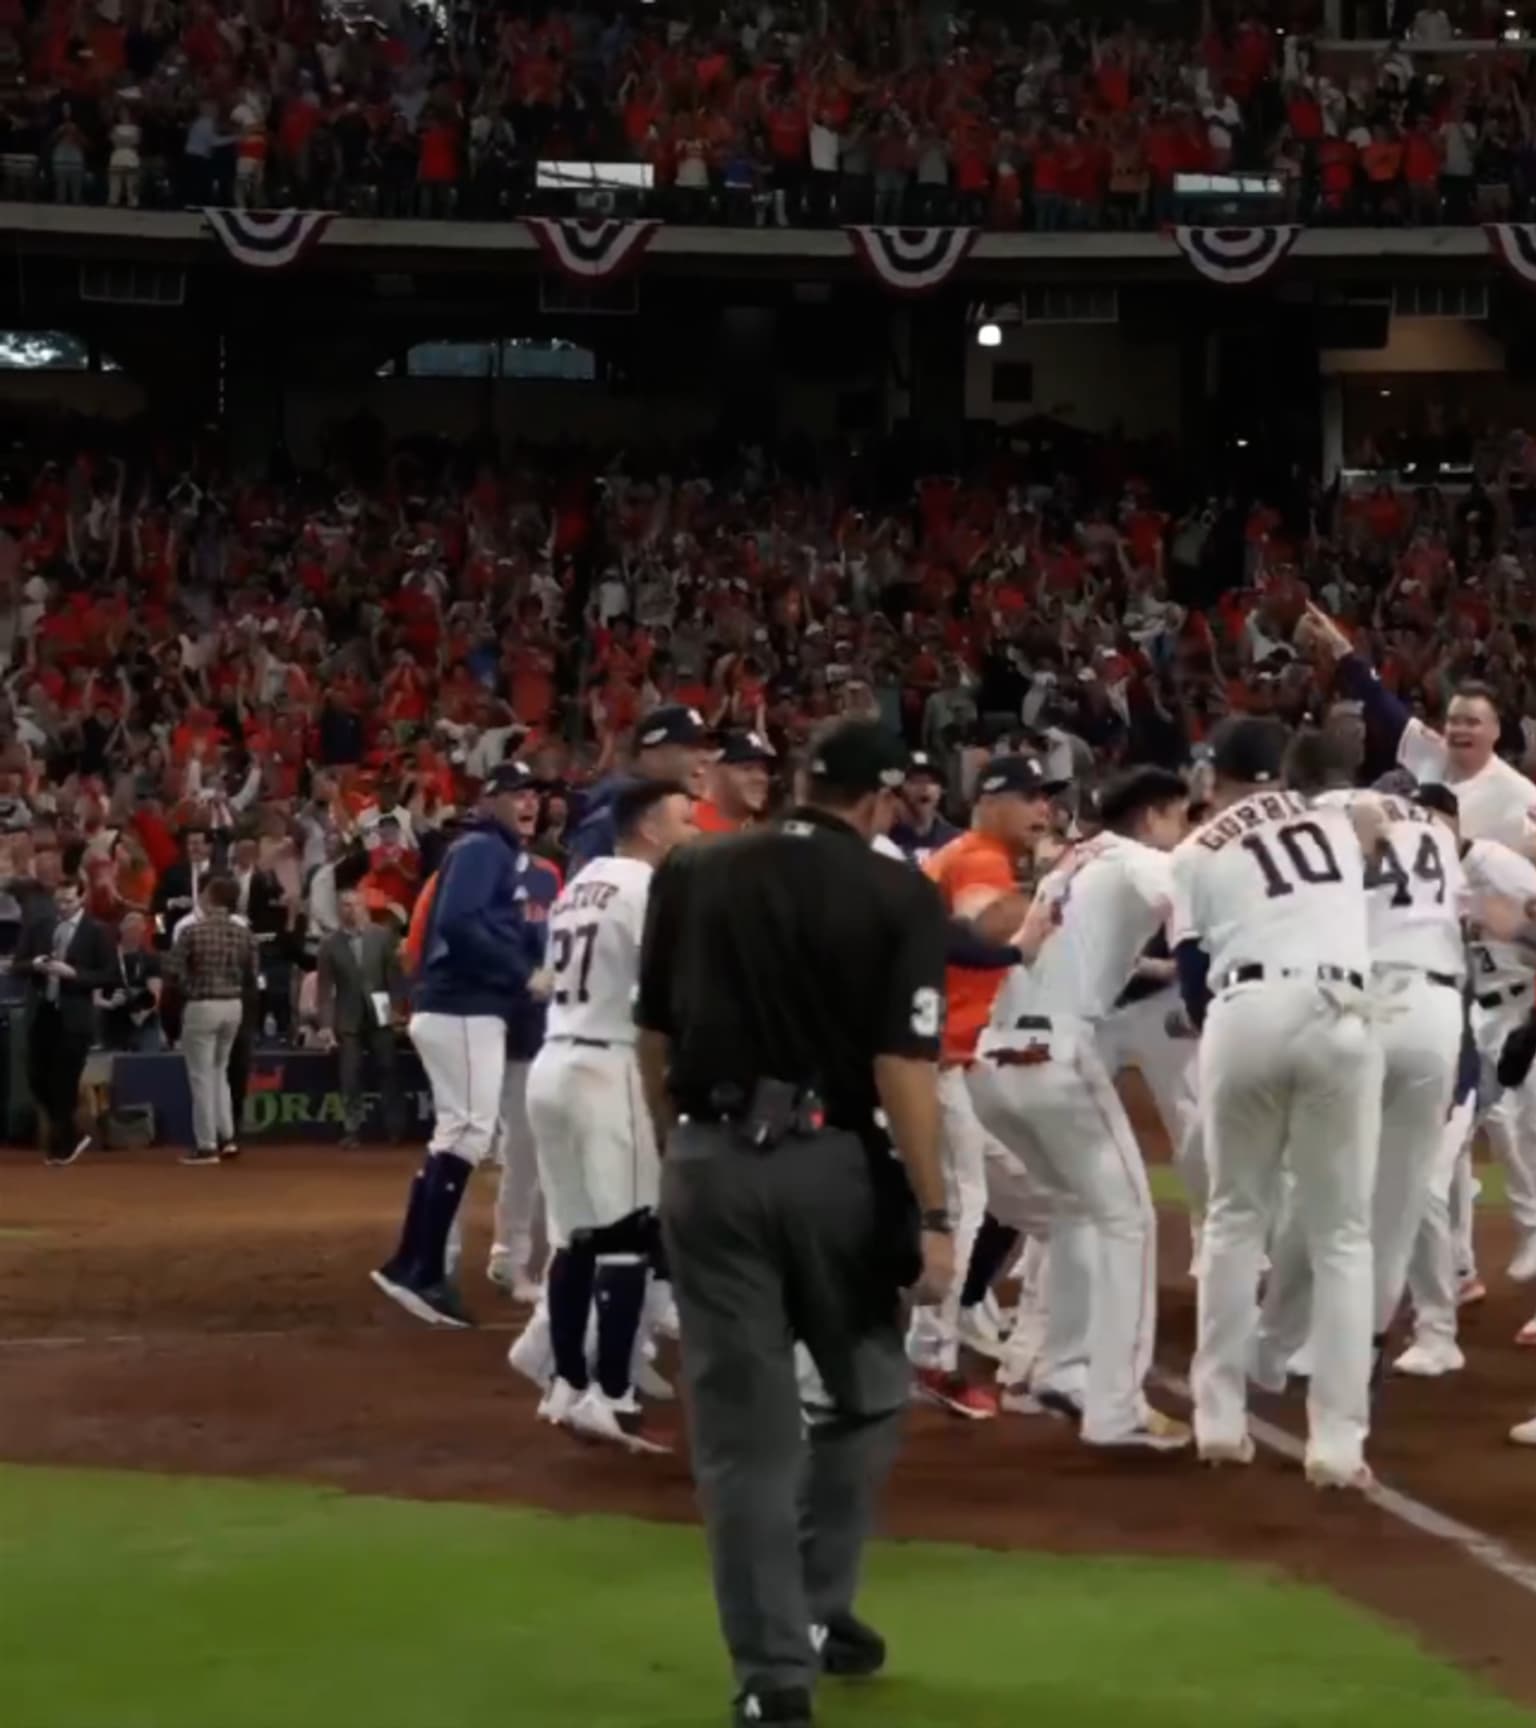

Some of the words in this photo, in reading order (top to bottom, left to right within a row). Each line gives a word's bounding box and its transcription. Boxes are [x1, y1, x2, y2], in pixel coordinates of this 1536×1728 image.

[1240, 822, 1342, 899] 10
[1363, 834, 1445, 906] 44
[552, 922, 599, 1005] 27
[909, 986, 940, 1037] 3
